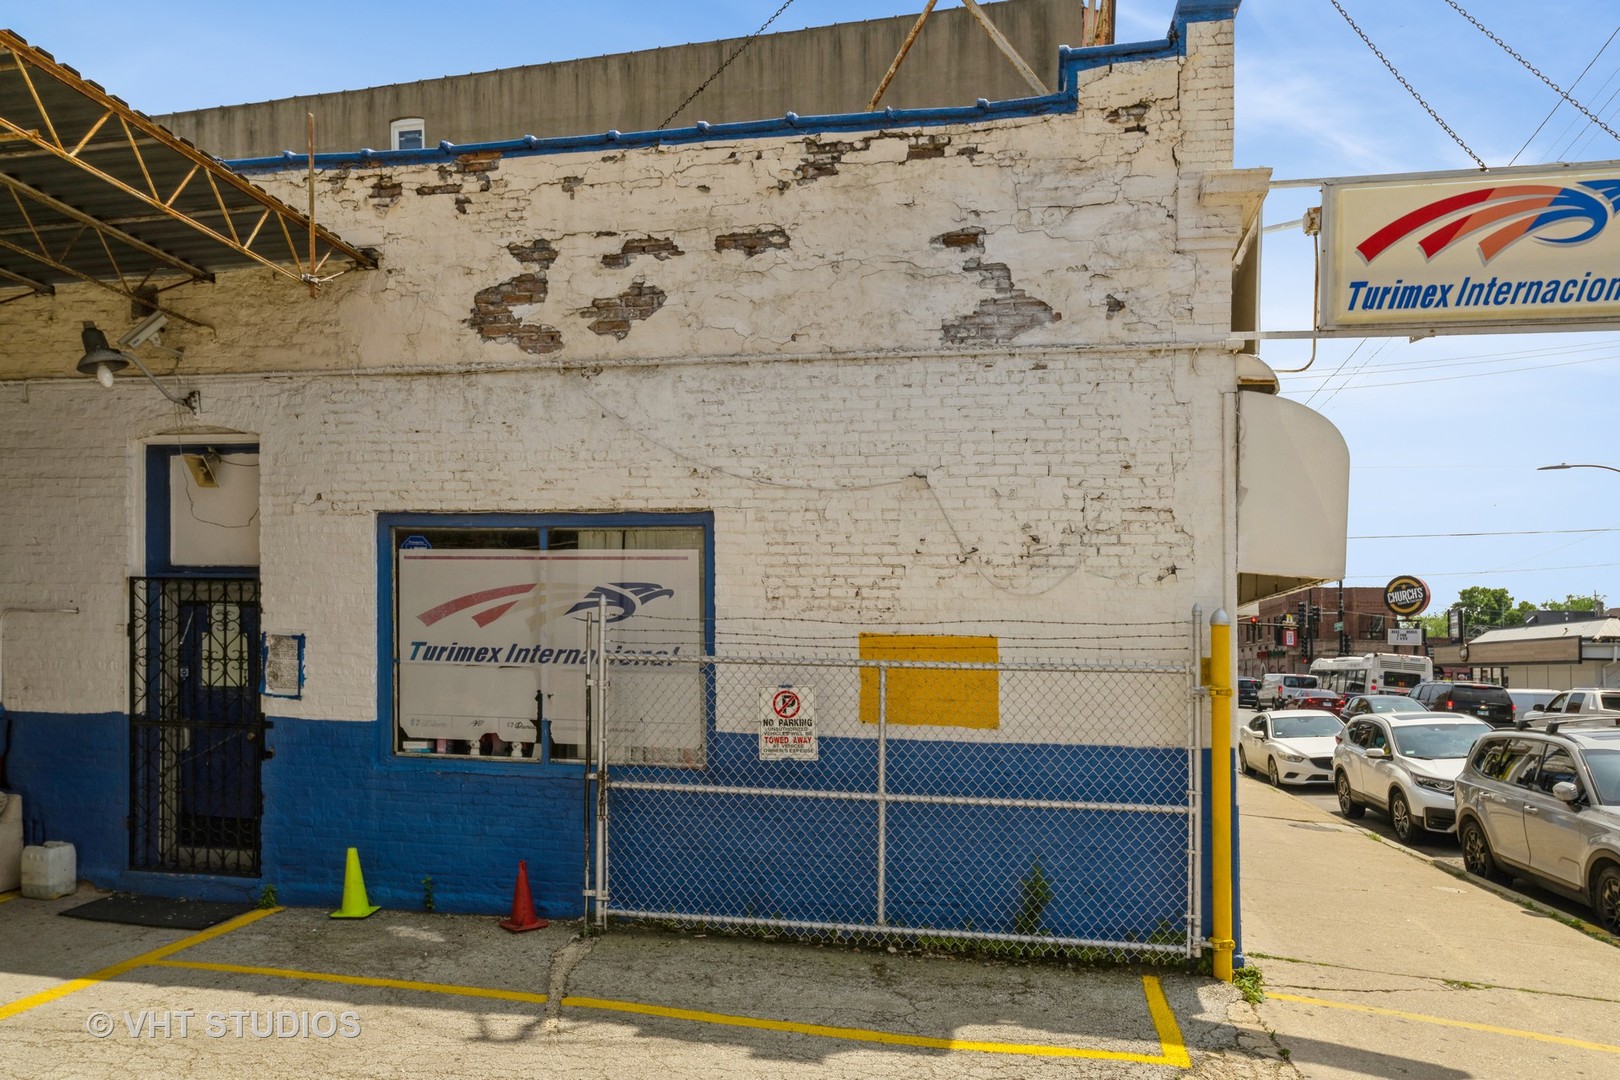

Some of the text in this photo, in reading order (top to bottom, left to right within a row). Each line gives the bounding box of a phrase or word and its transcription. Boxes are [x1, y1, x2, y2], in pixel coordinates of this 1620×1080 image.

[1348, 271, 1620, 311] Turimex Internacion
[409, 641, 503, 663] Turimex
[763, 718, 813, 727] NO PARKING
[764, 736, 812, 744] TOWED AWAY
